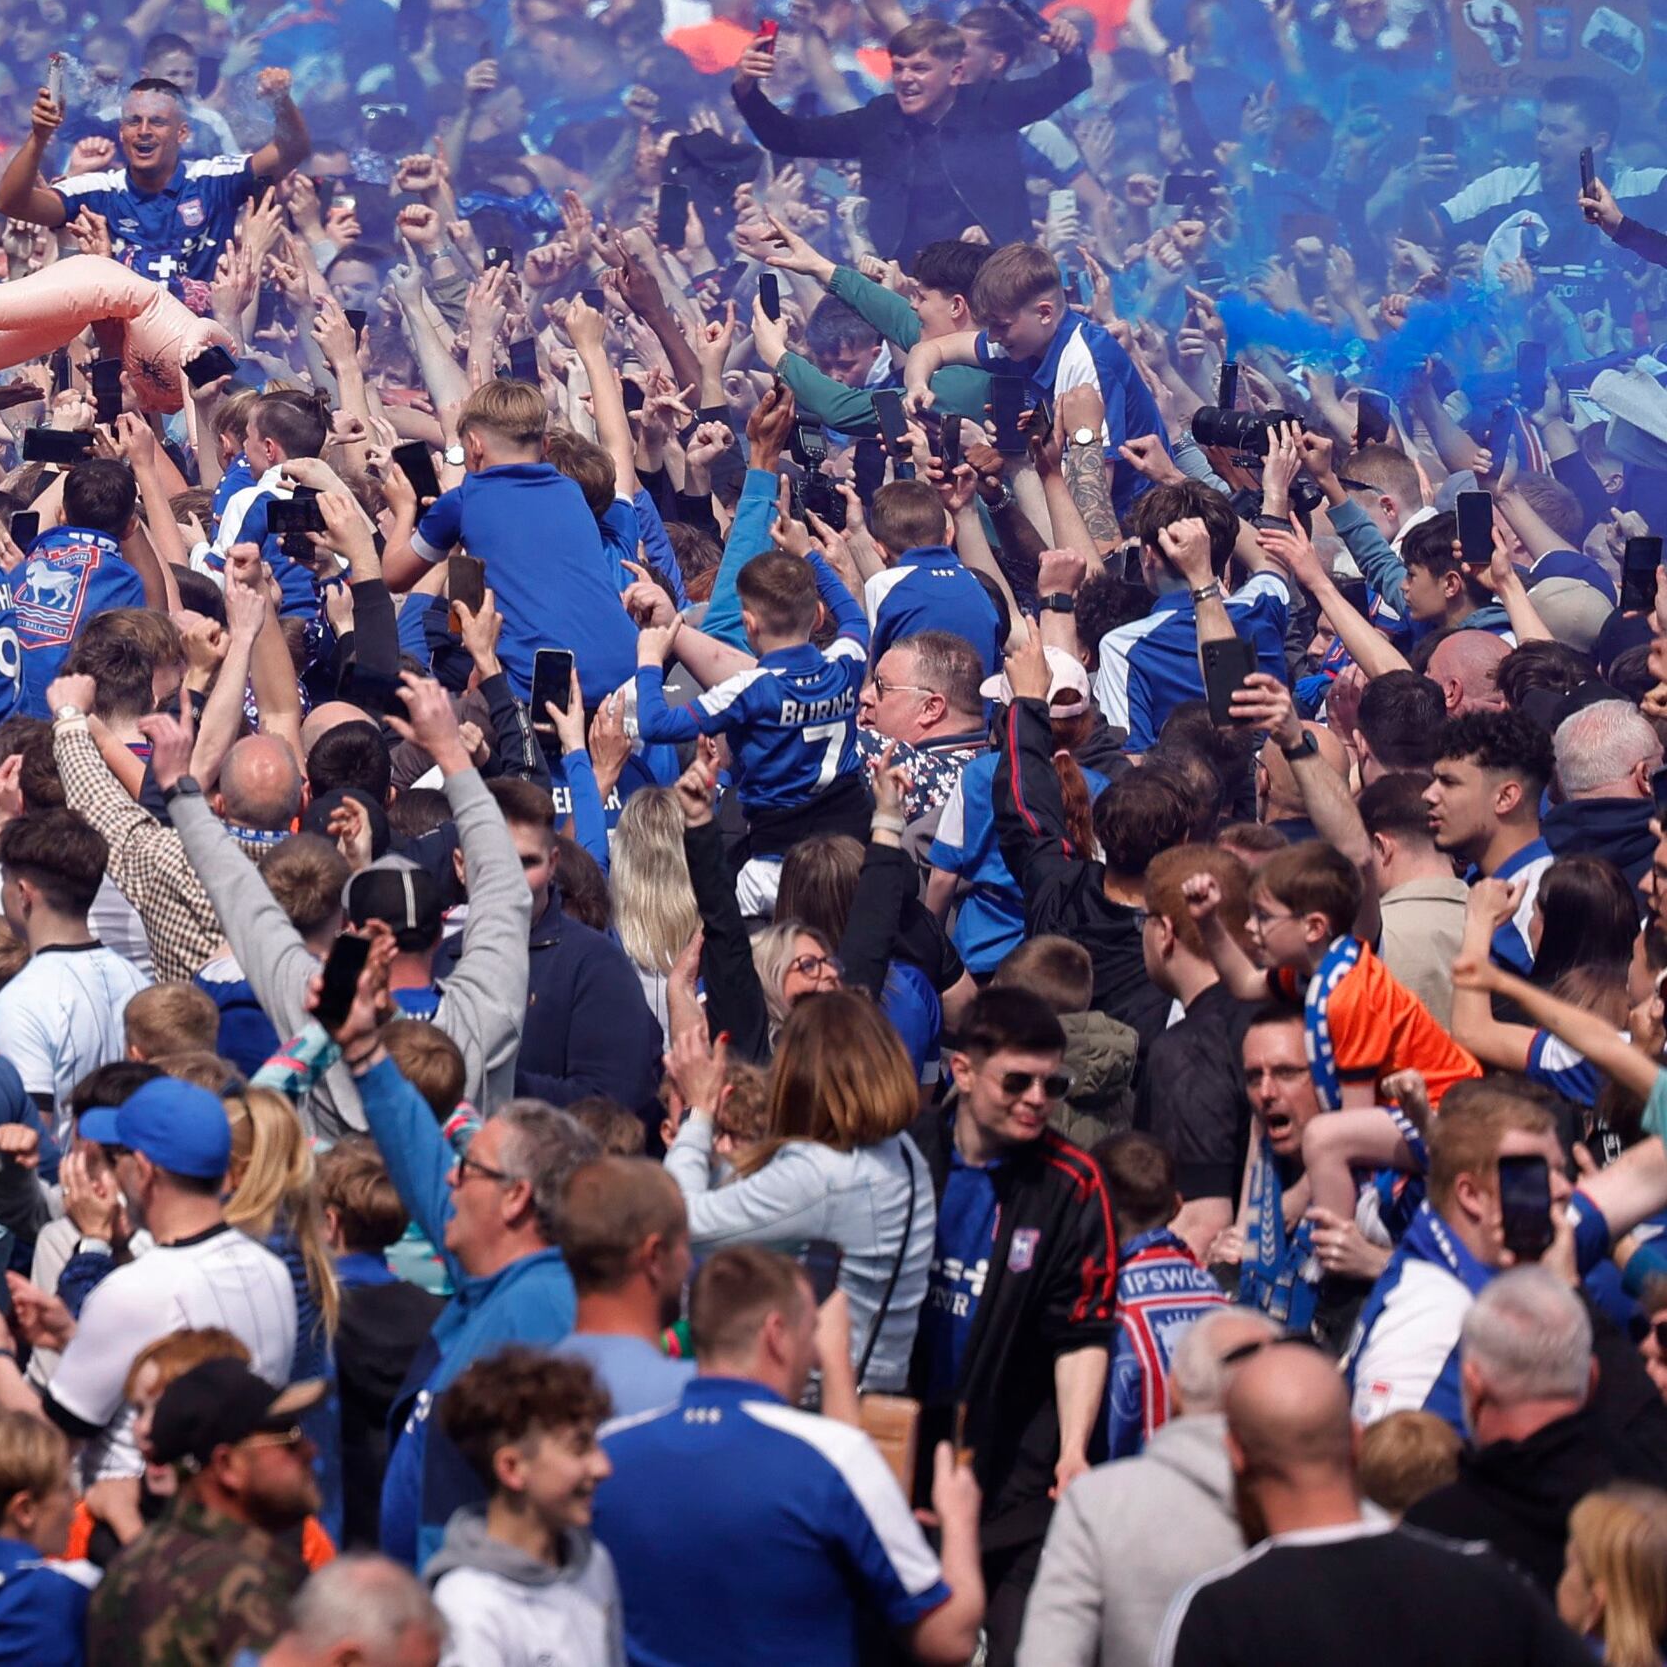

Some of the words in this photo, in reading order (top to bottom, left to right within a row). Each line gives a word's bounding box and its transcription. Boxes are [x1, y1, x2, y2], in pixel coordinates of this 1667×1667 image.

[779, 685, 856, 727] BURNS
[802, 720, 847, 794] 7
[1123, 1267, 1214, 1294] IPSWIC
